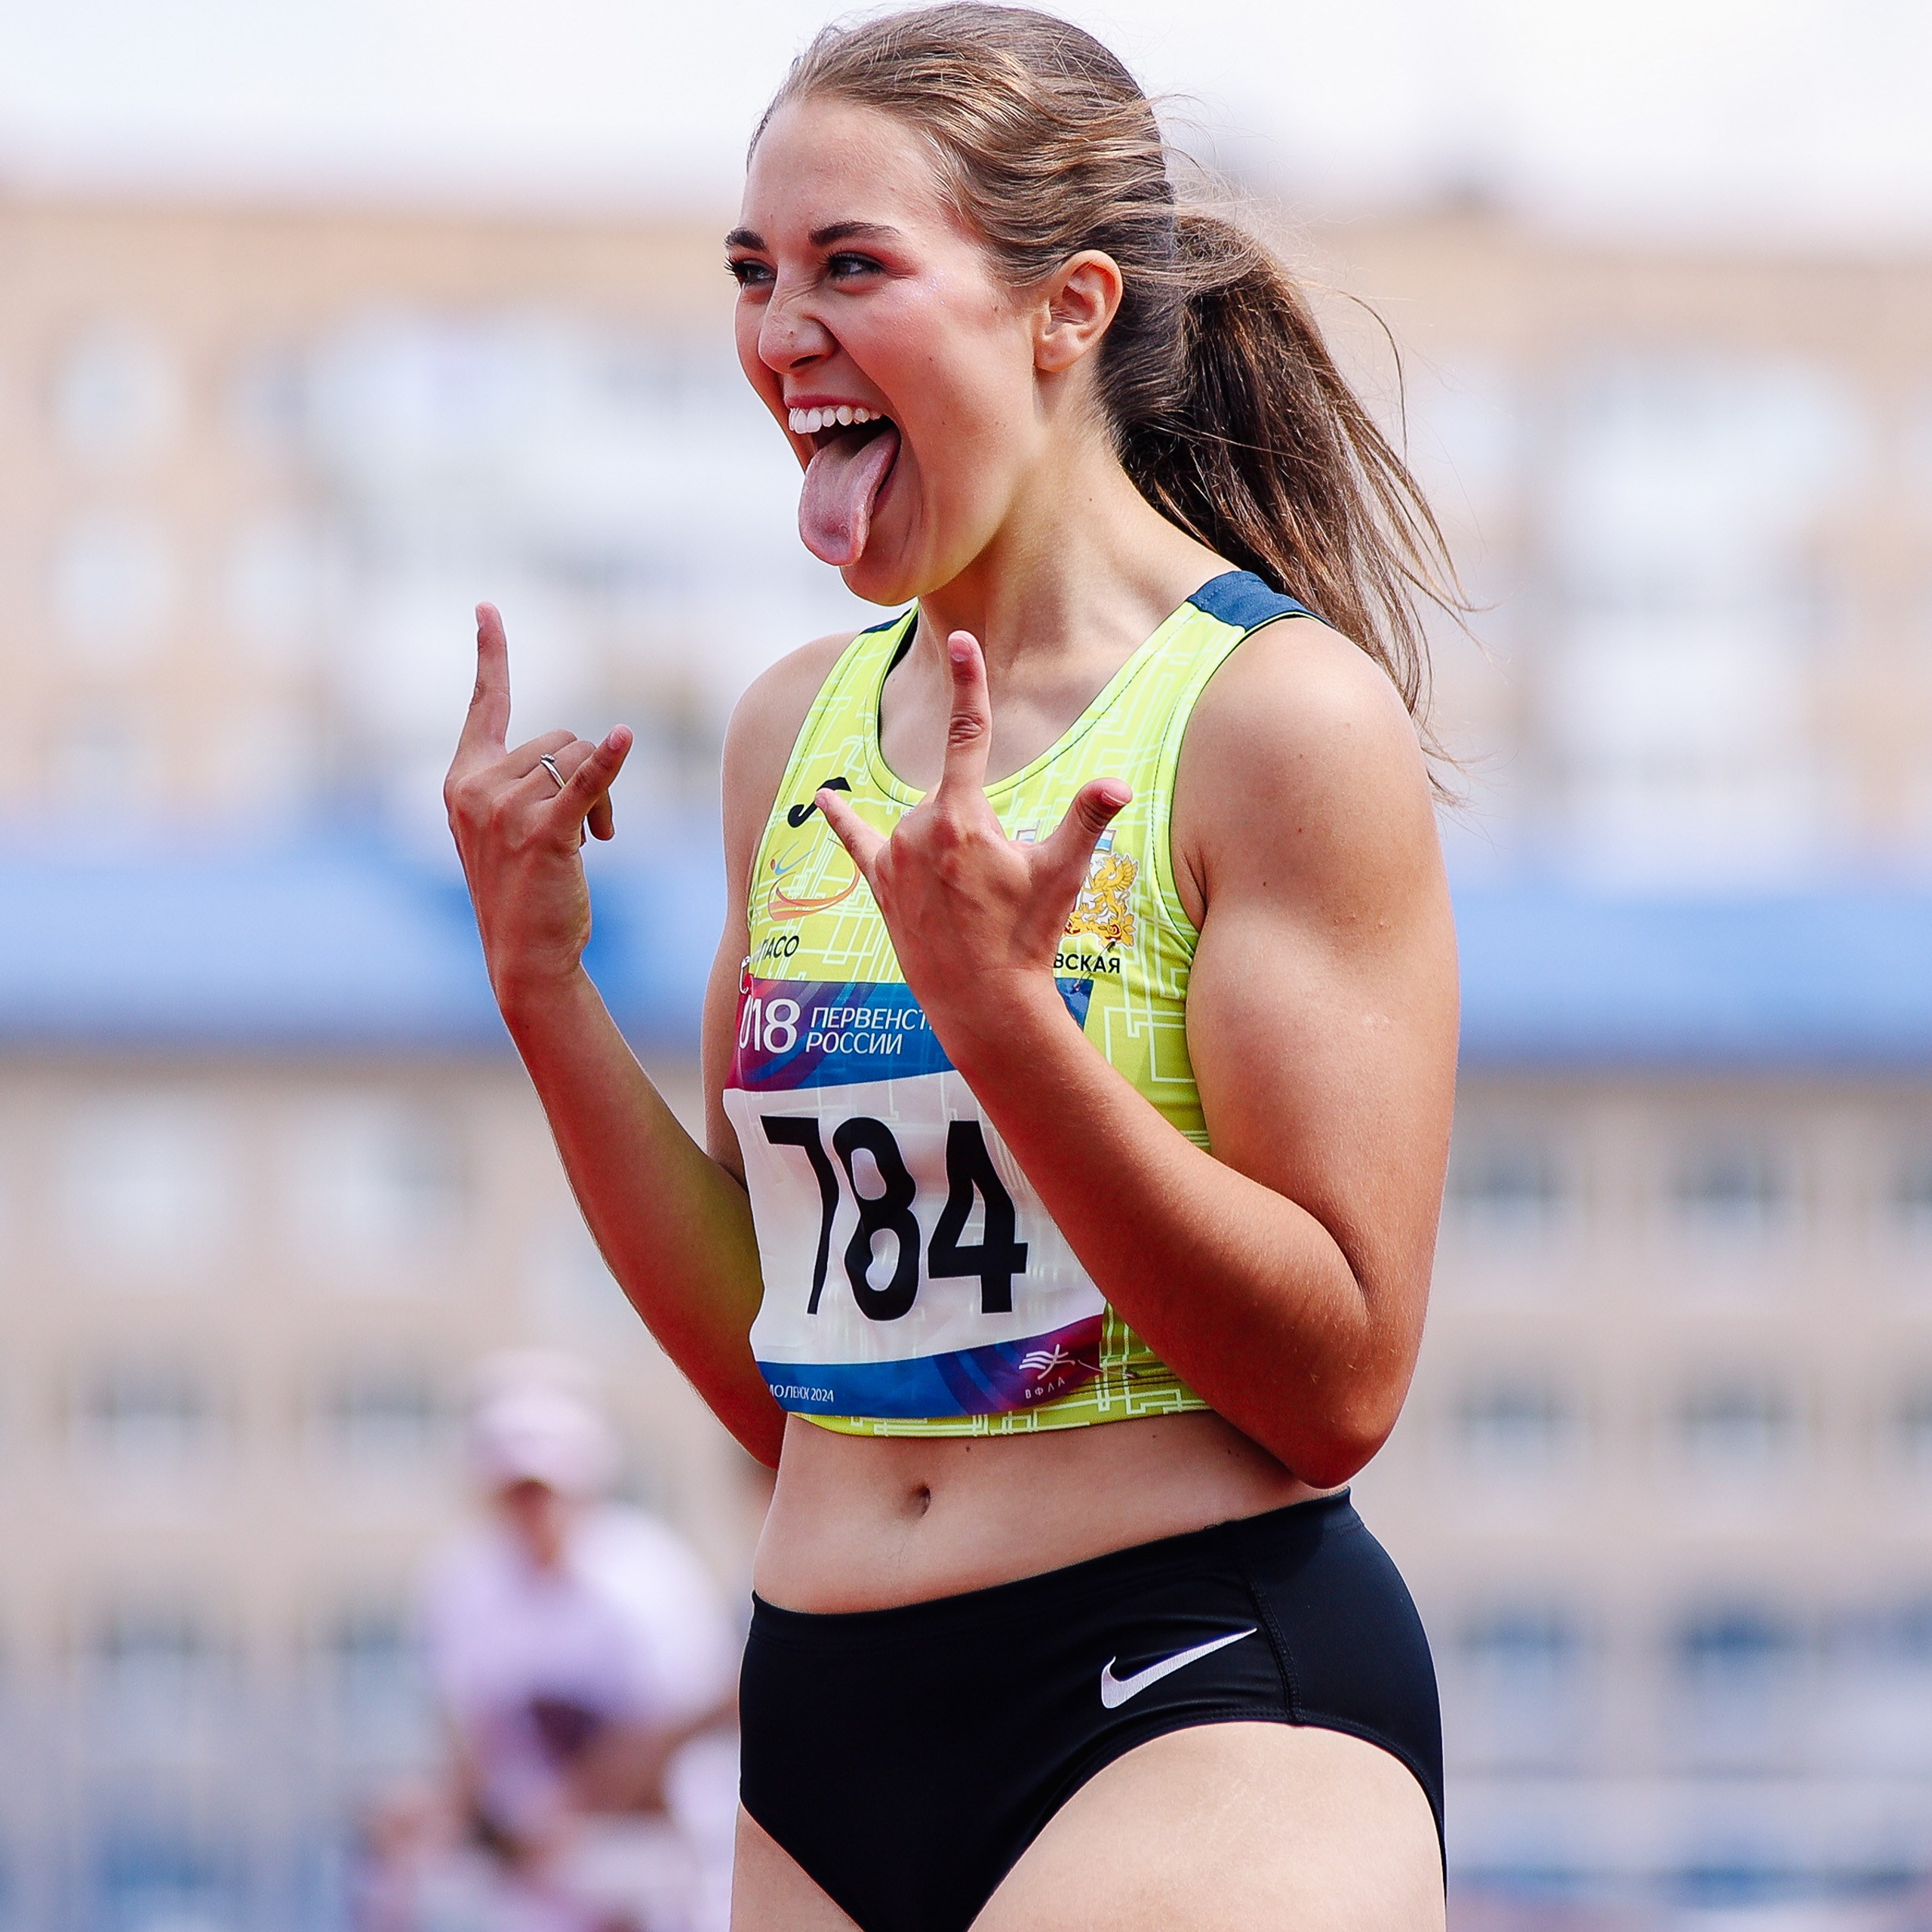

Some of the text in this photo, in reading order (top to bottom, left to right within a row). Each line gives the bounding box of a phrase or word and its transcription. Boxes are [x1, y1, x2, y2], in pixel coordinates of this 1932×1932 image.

[811, 1007, 933, 1031] ПЕРВЕНСТ
[805, 1032, 903, 1055] РОССИИ
[759, 1115, 1029, 1322] 784
[811, 1387, 834, 1403] 2024
